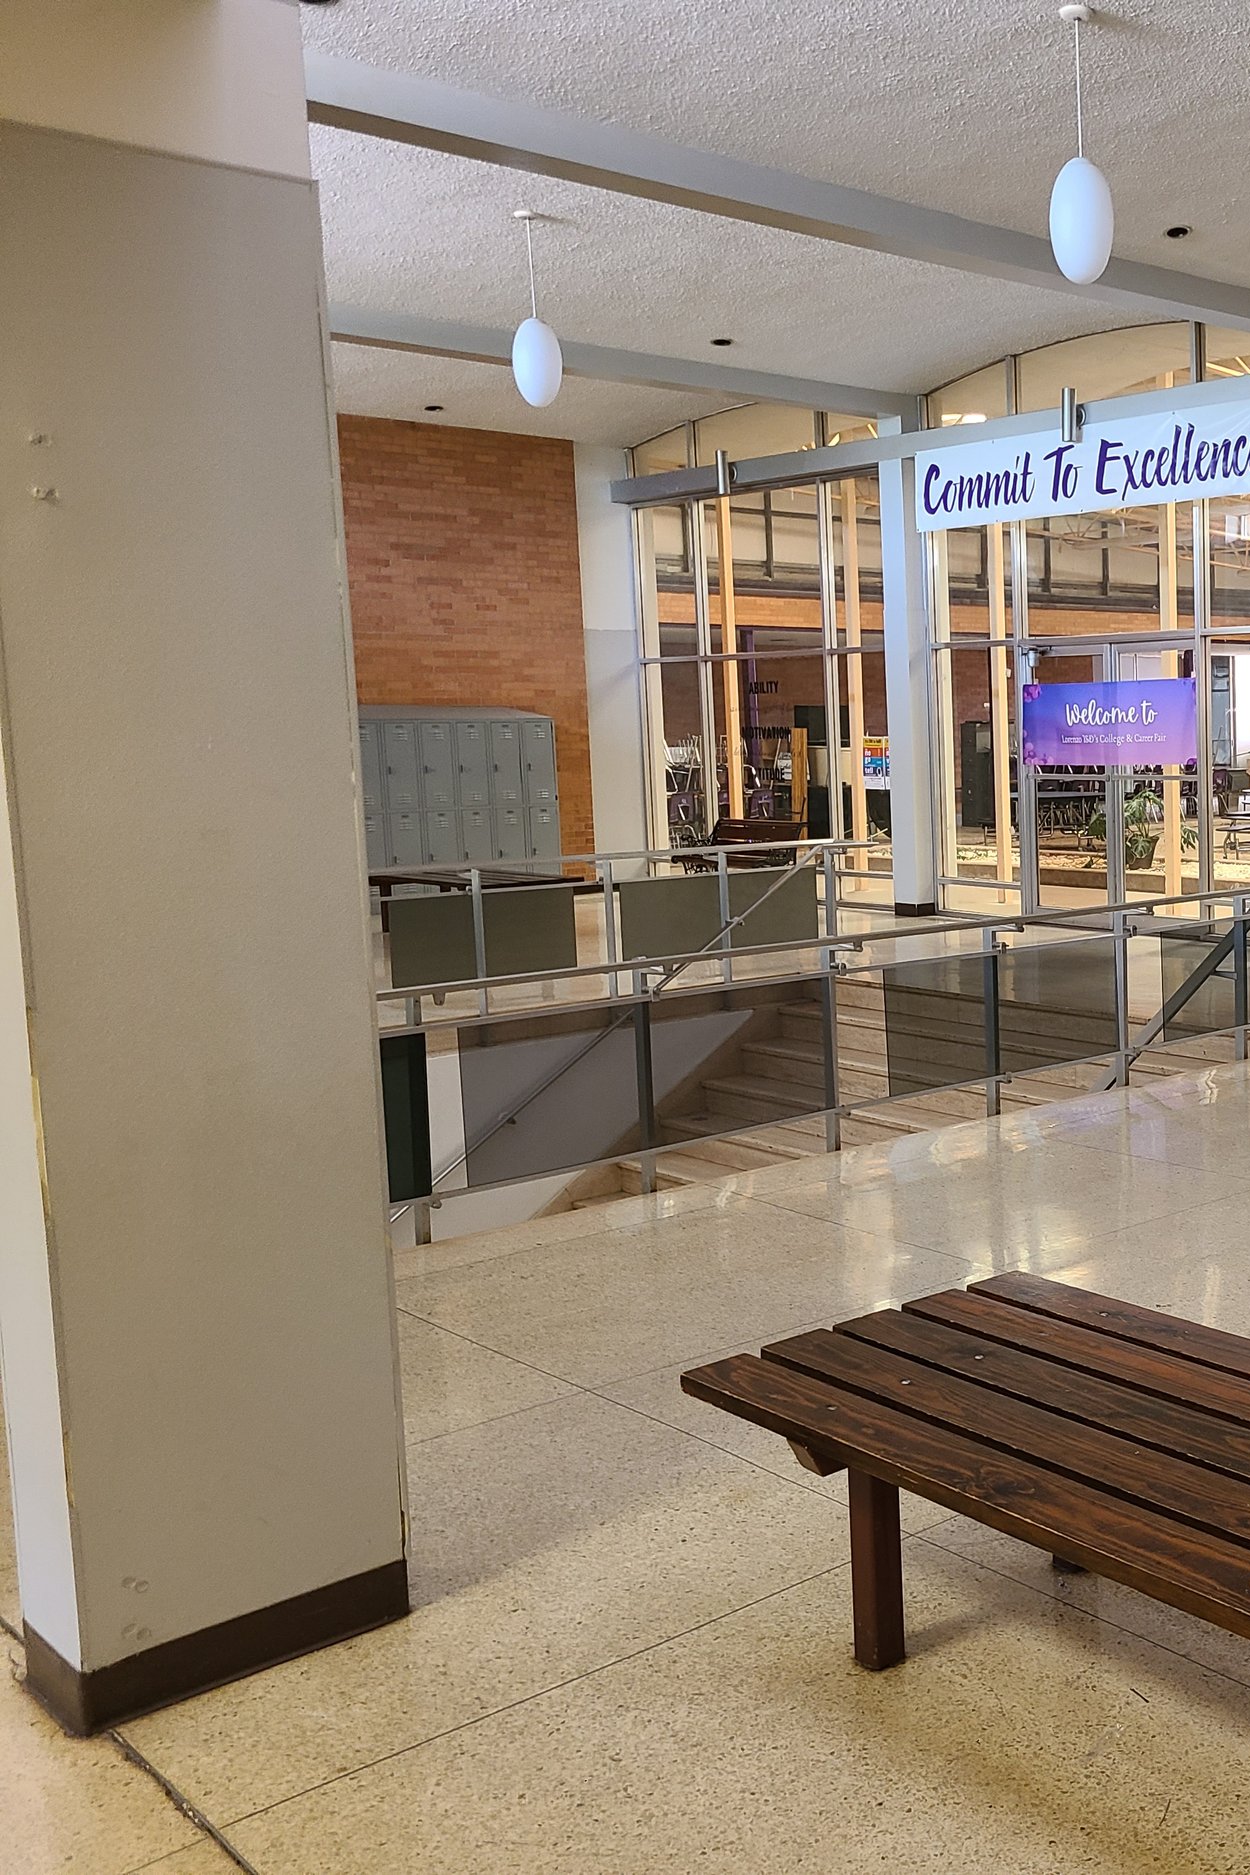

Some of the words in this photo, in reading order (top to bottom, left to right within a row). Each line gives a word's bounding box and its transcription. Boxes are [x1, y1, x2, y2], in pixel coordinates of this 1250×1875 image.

[923, 451, 1036, 515] Commit
[1042, 443, 1084, 502] To
[749, 681, 779, 694] ABILITY
[1065, 699, 1139, 727] Welcome
[1140, 700, 1158, 726] to
[742, 726, 791, 740] MOTIVATION
[1099, 733, 1125, 747] College
[1126, 733, 1134, 743] &
[1134, 733, 1153, 743] Career
[1153, 732, 1167, 742] Fair
